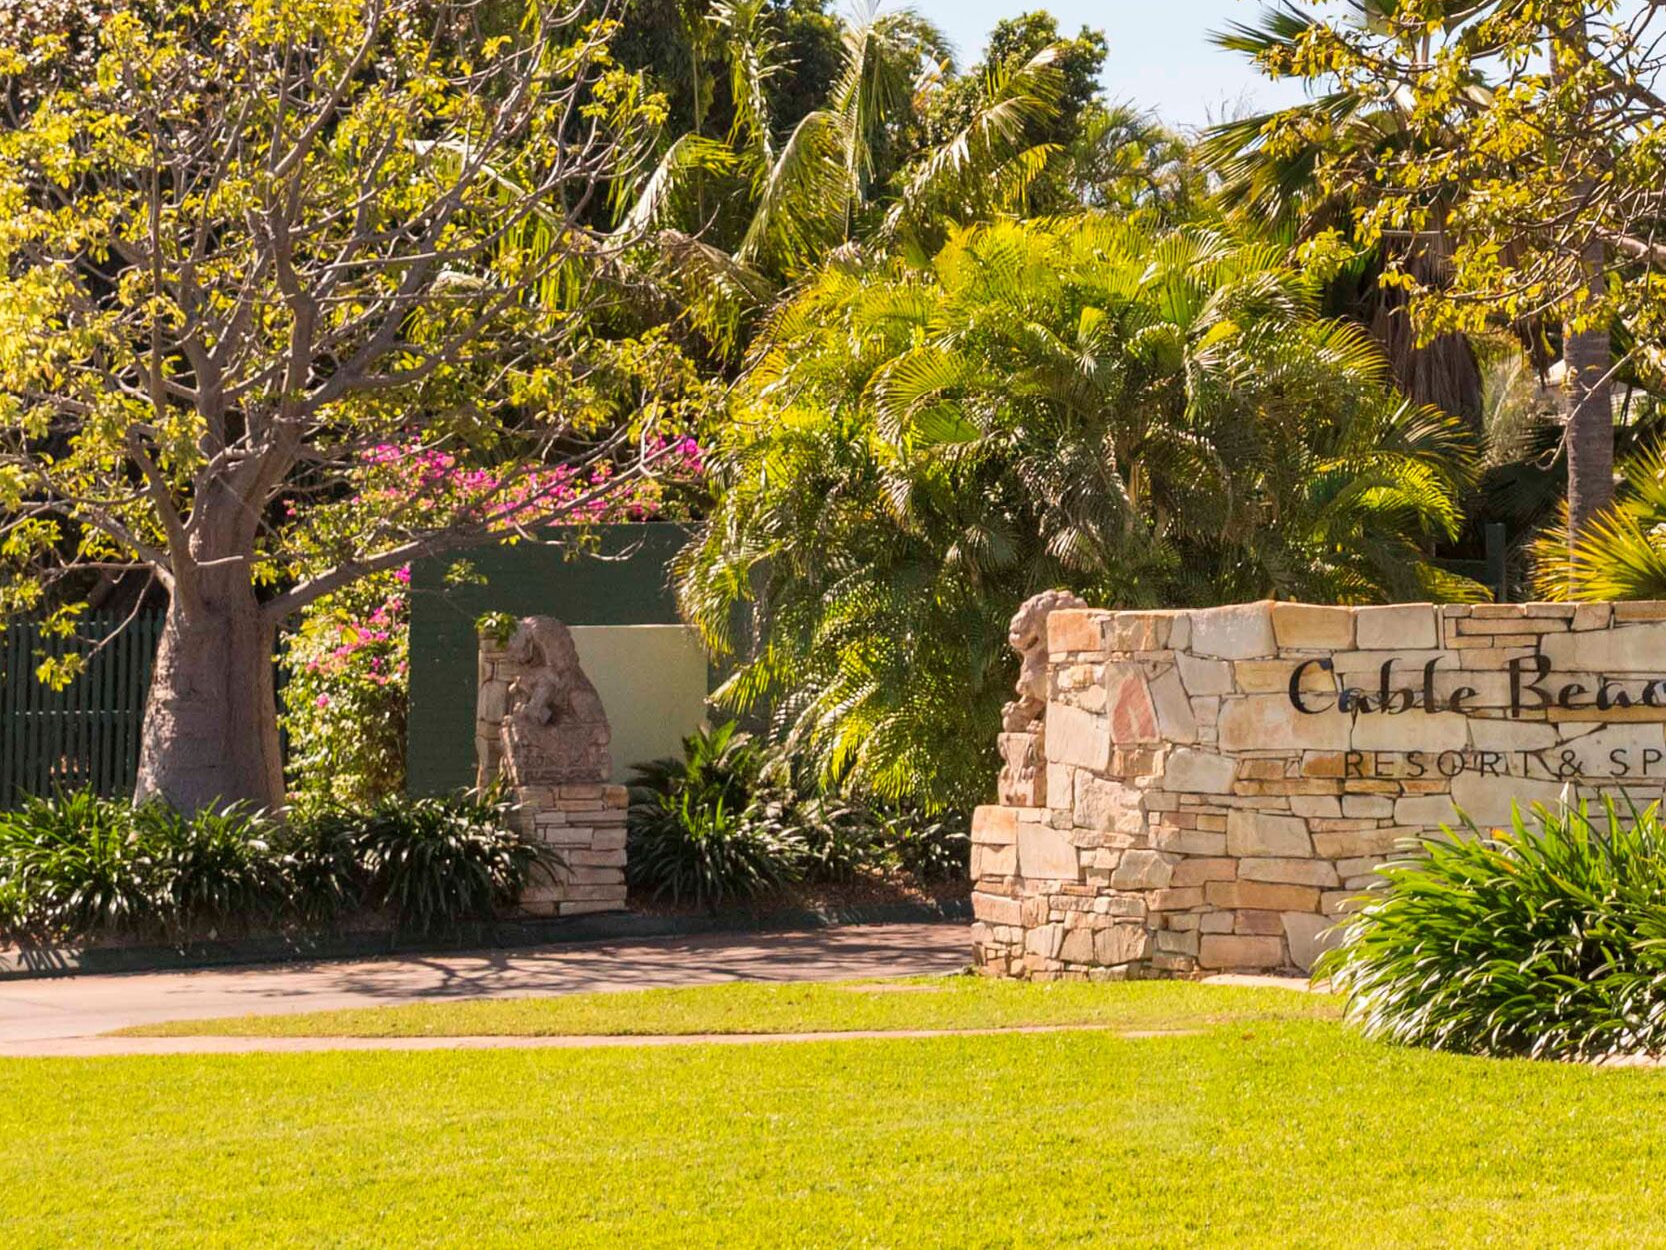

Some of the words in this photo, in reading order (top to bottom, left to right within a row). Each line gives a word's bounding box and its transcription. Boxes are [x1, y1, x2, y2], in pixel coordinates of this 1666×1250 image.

[1289, 656, 1479, 715] Cable
[1344, 749, 1541, 778] RESORT
[1558, 749, 1585, 777] &
